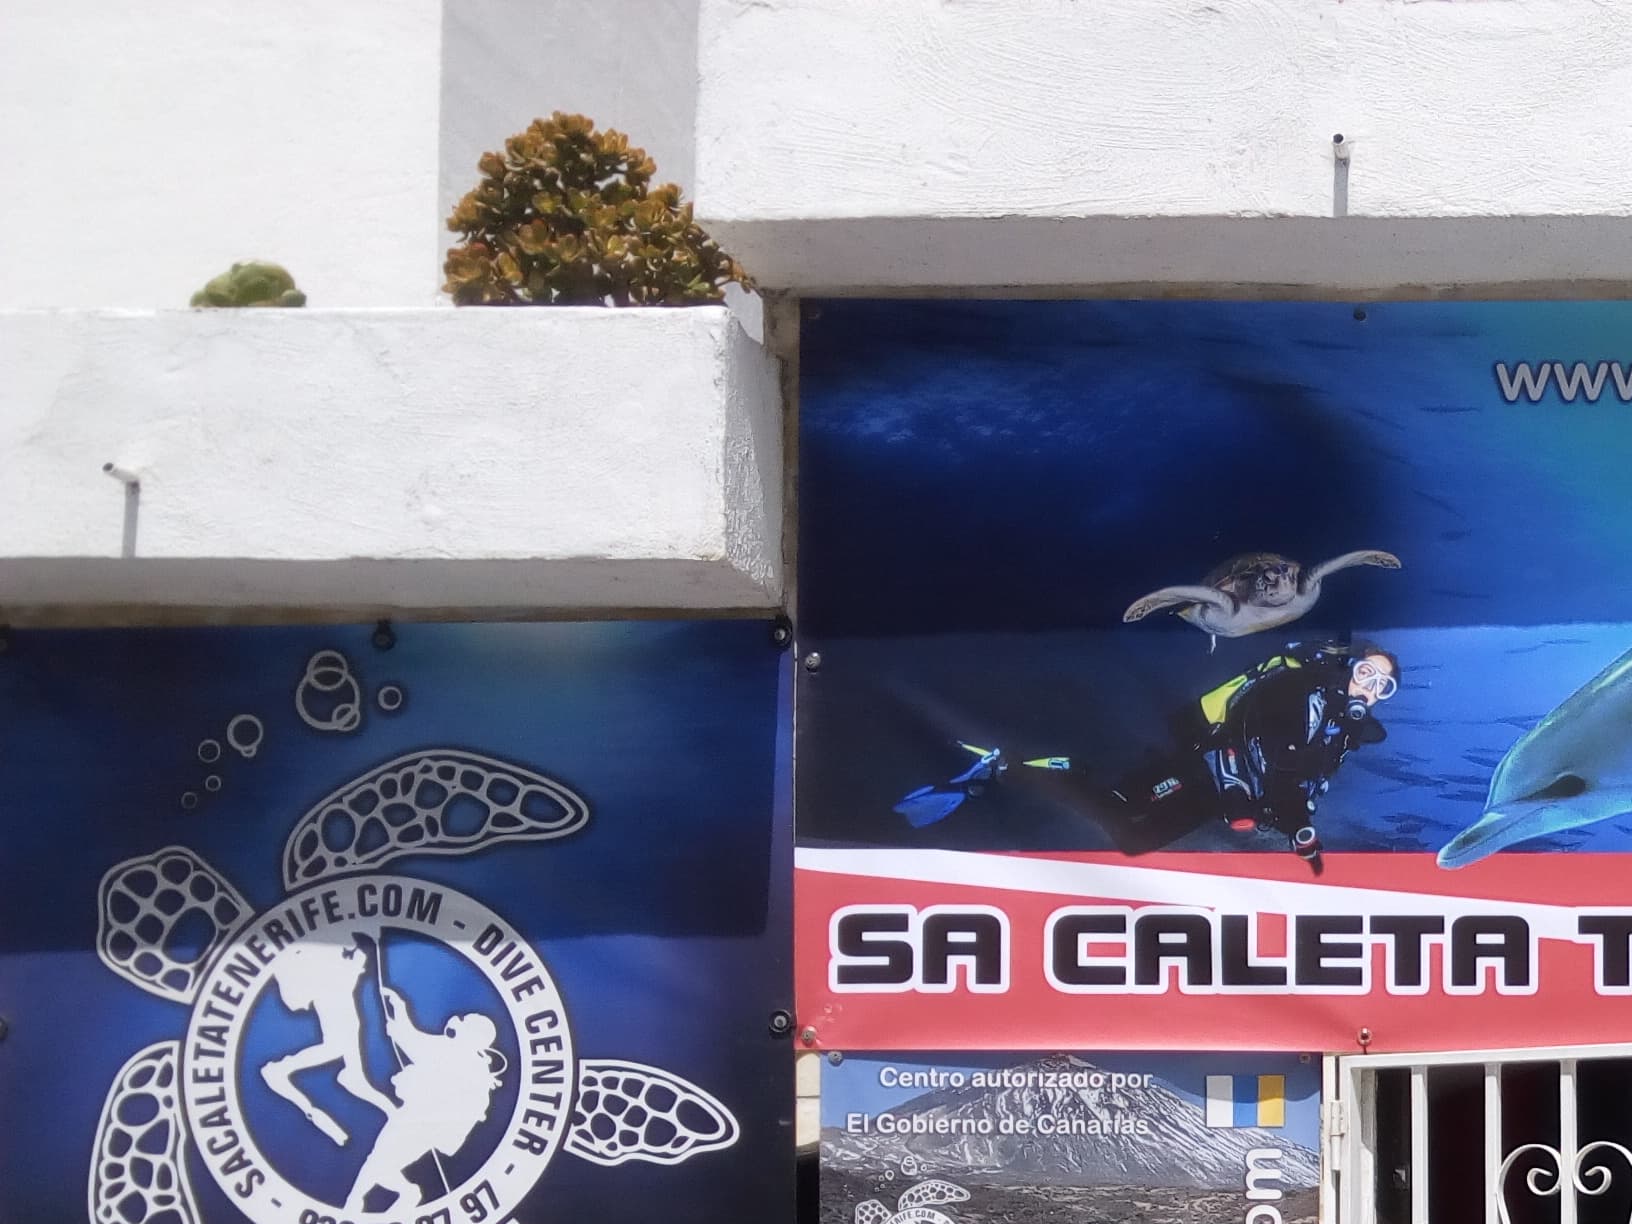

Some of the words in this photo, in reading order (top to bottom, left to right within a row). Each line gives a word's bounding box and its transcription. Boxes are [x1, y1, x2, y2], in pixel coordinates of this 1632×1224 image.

[472, 923, 545, 1002] DIVE
[836, 913, 1002, 986] SA
[1052, 912, 1531, 986] CALETA
[193, 883, 443, 1199] SACALETATENERIFE.COM
[879, 1066, 967, 1089] Centro
[971, 1068, 1106, 1089] autorizado
[513, 1009, 565, 1157] CENTER
[847, 1113, 869, 1134] El
[876, 1112, 992, 1135] Gobierno
[999, 1113, 1028, 1135] de
[1038, 1113, 1149, 1135] Canarias
[461, 1179, 501, 1224] 97
